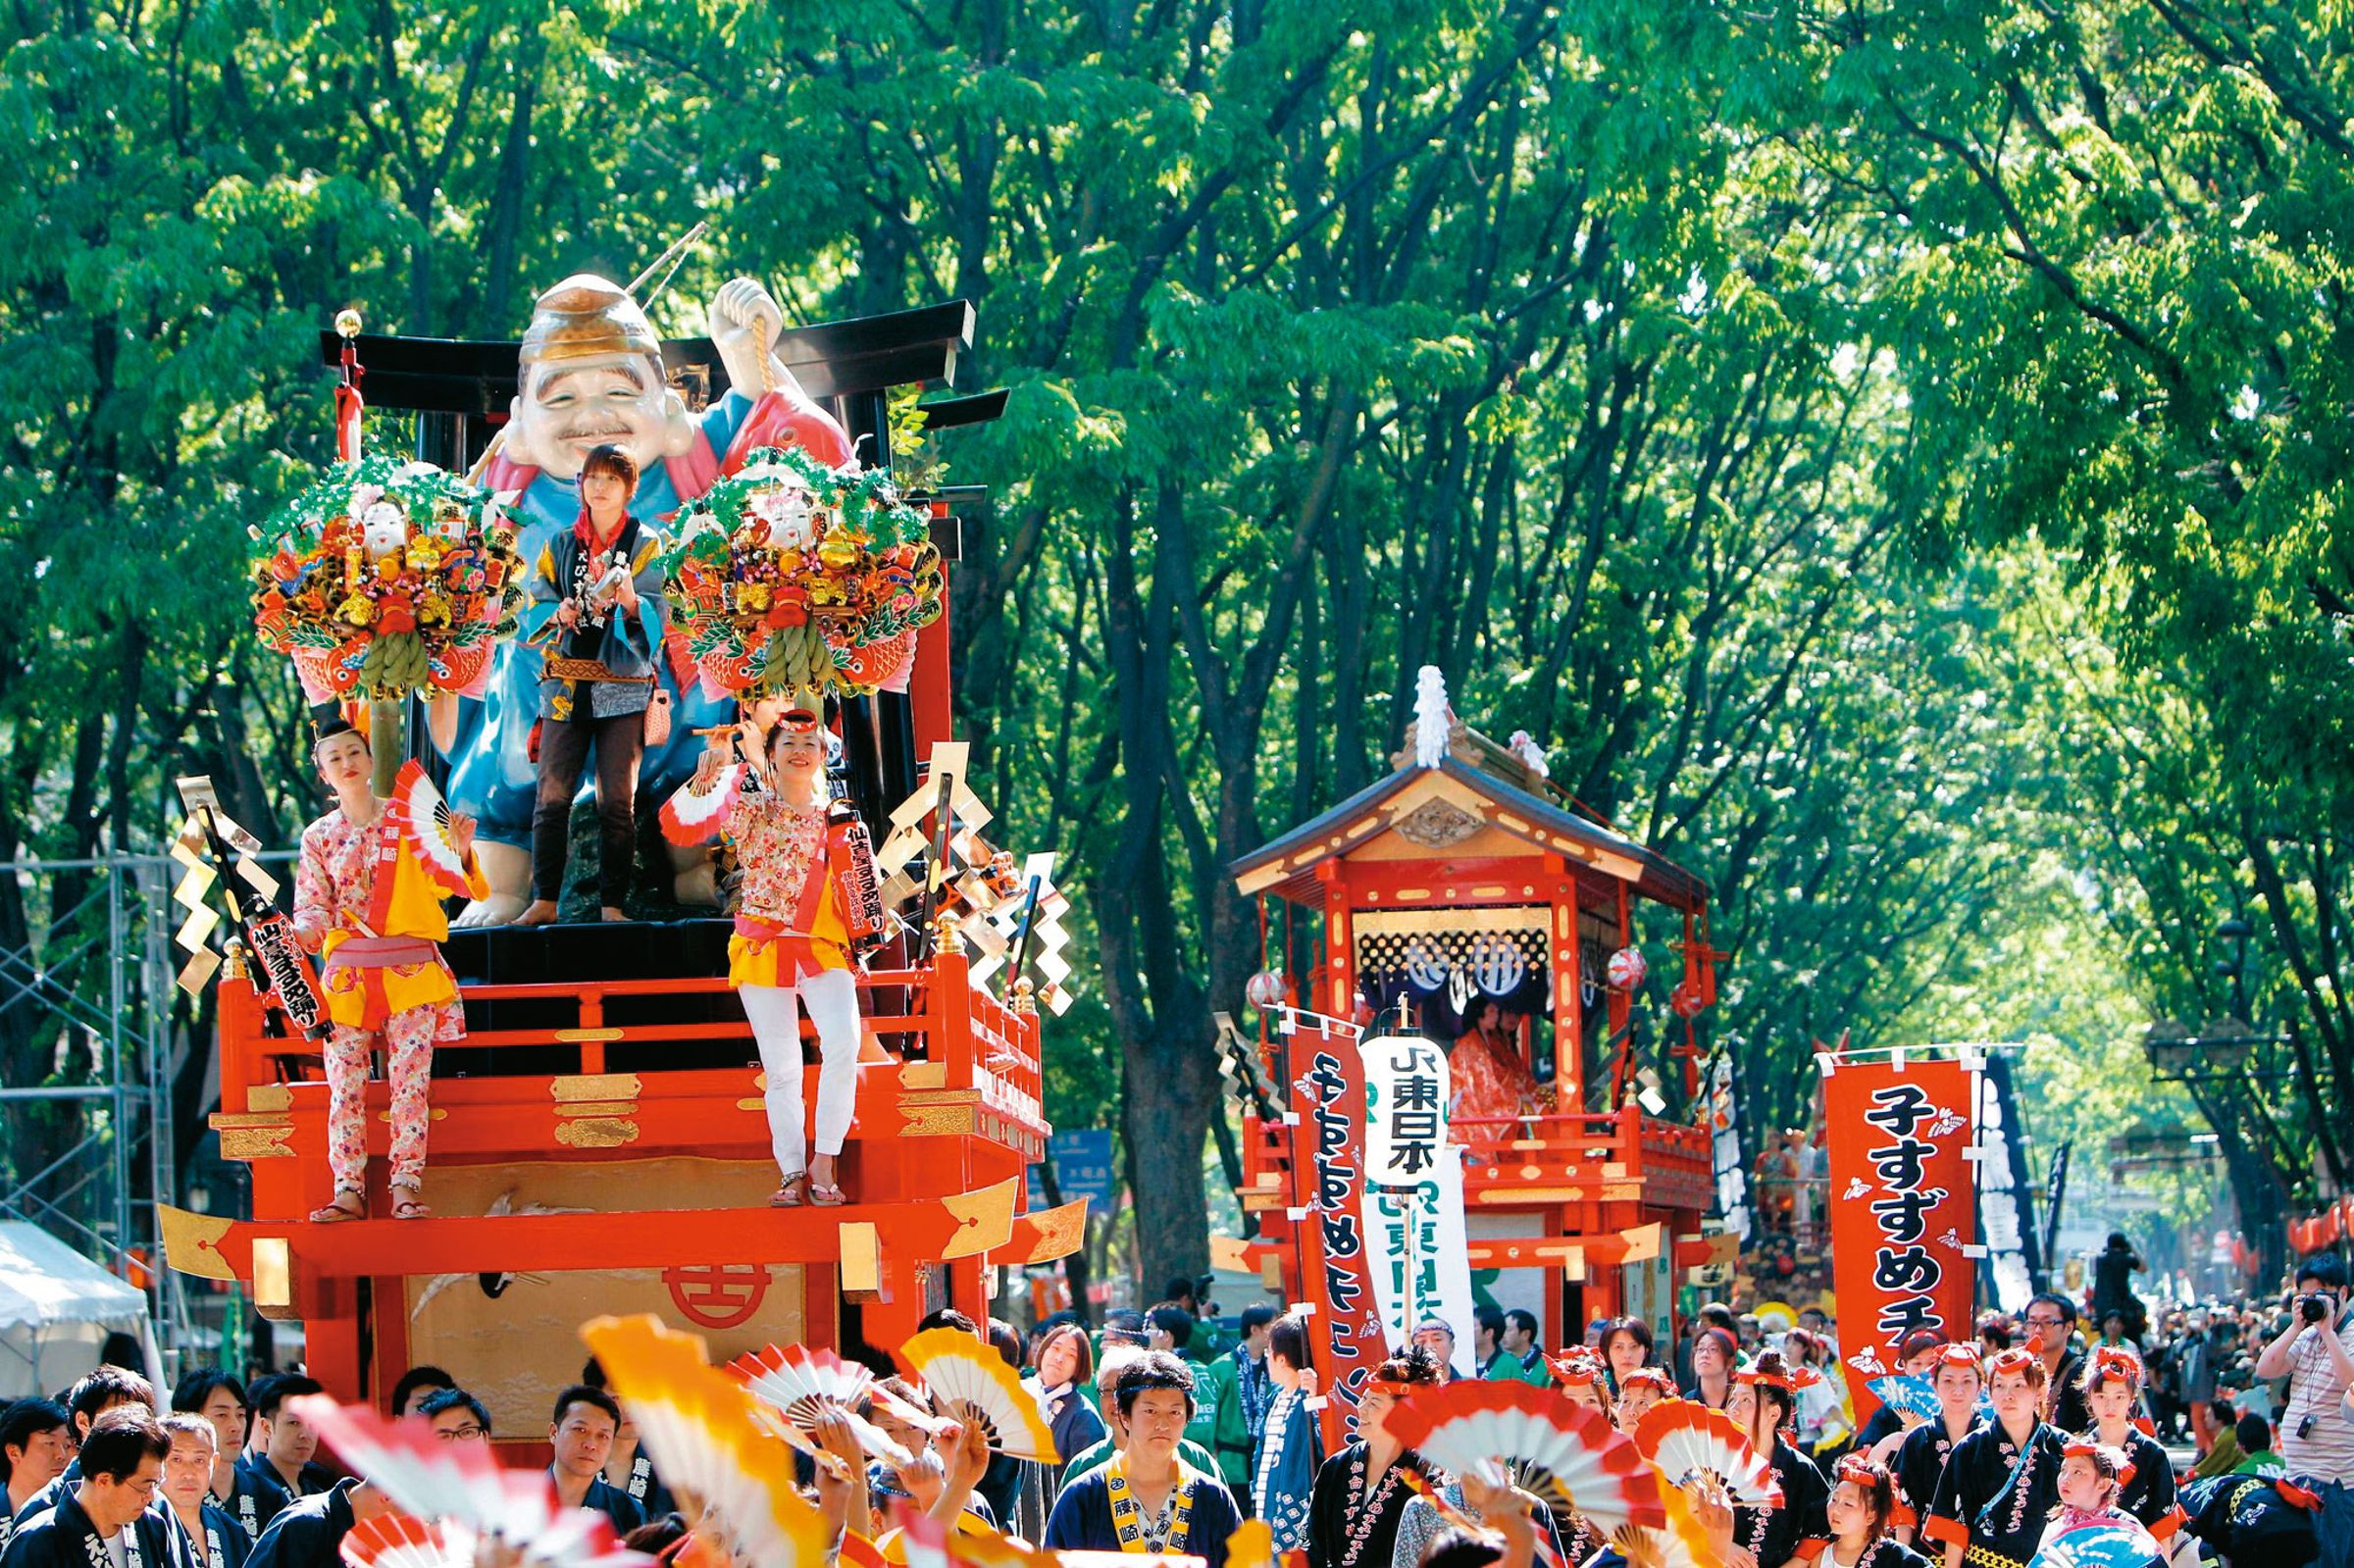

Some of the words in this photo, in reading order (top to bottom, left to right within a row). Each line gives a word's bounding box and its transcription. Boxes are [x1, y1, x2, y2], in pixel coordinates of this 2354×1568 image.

[1387, 1046, 1439, 1175] JR東日本
[1864, 1083, 1948, 1369] 子すずめチ
[1112, 1497, 1140, 1544] 藤崎
